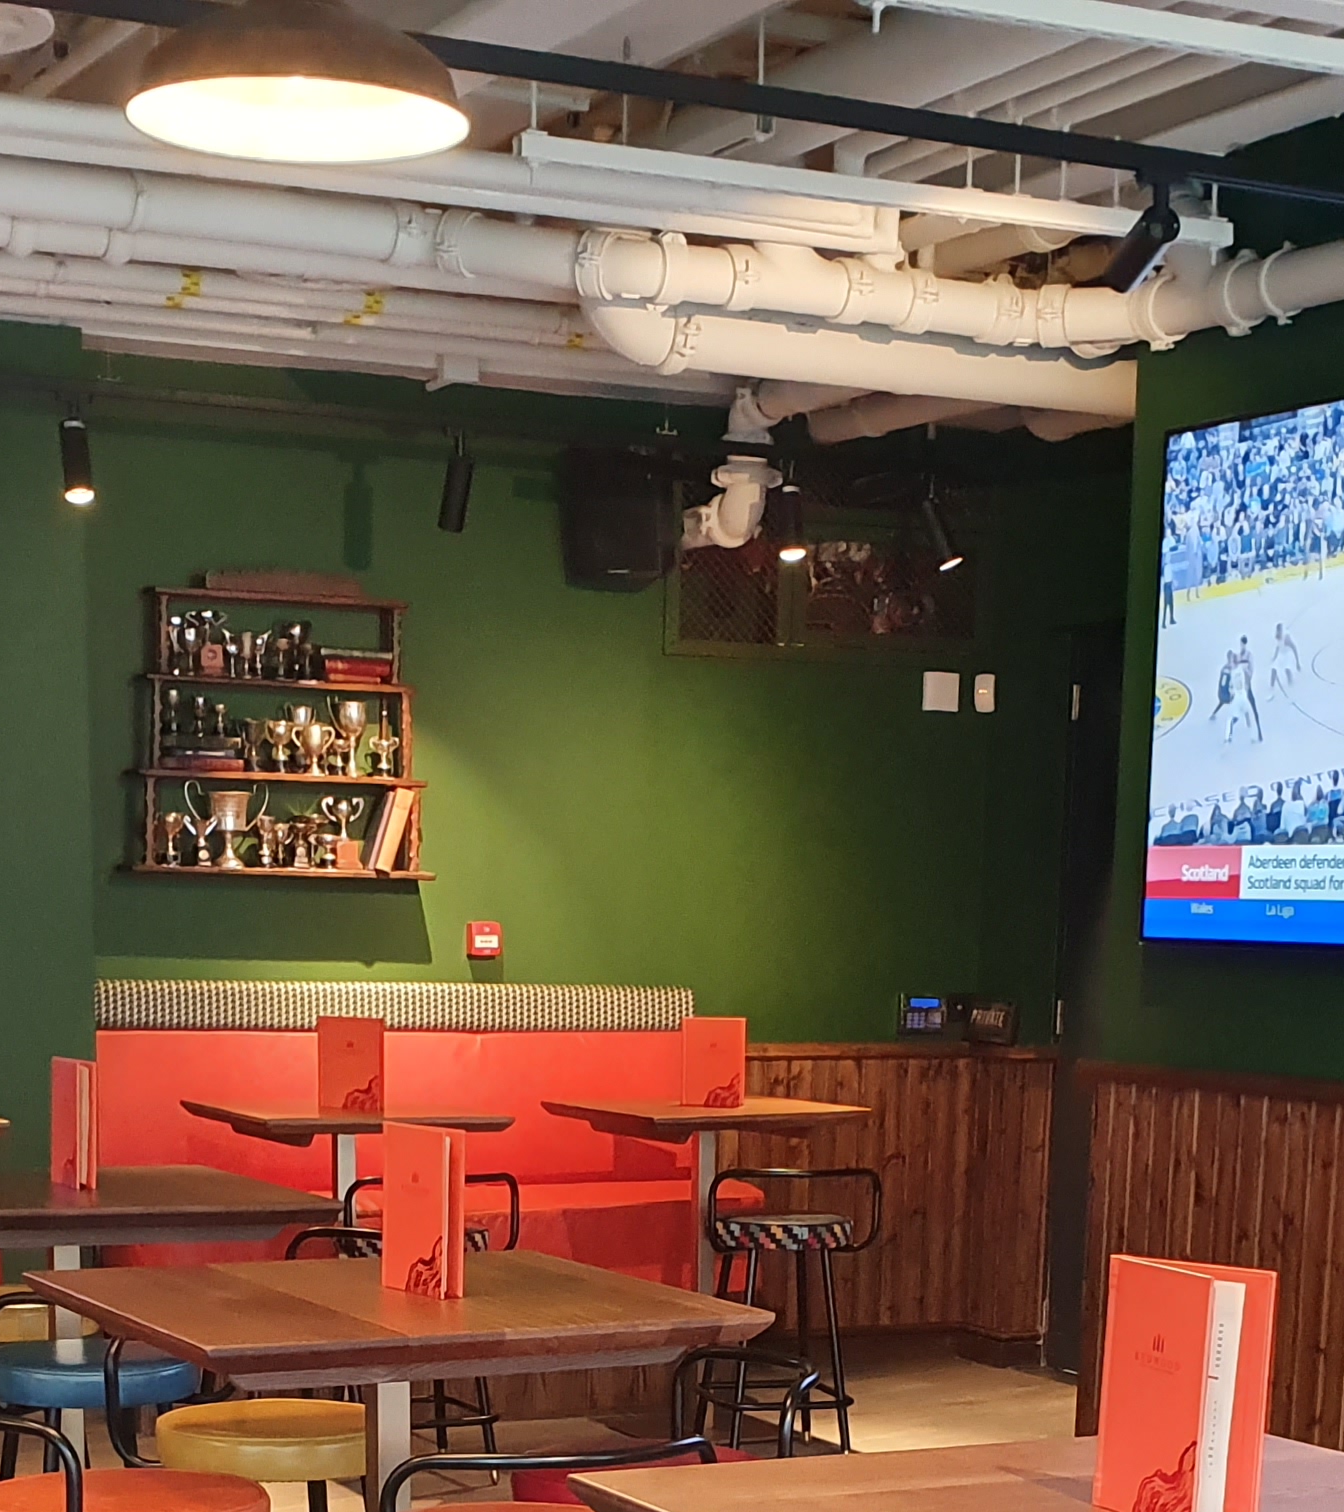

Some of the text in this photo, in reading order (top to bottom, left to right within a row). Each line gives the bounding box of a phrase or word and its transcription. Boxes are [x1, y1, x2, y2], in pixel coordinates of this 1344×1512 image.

[1247, 854, 1298, 870] Aberdeen
[1180, 864, 1230, 883] Scotland
[1247, 875, 1292, 891] Scotland
[1293, 876, 1327, 894] squad
[1265, 903, 1276, 916] La
